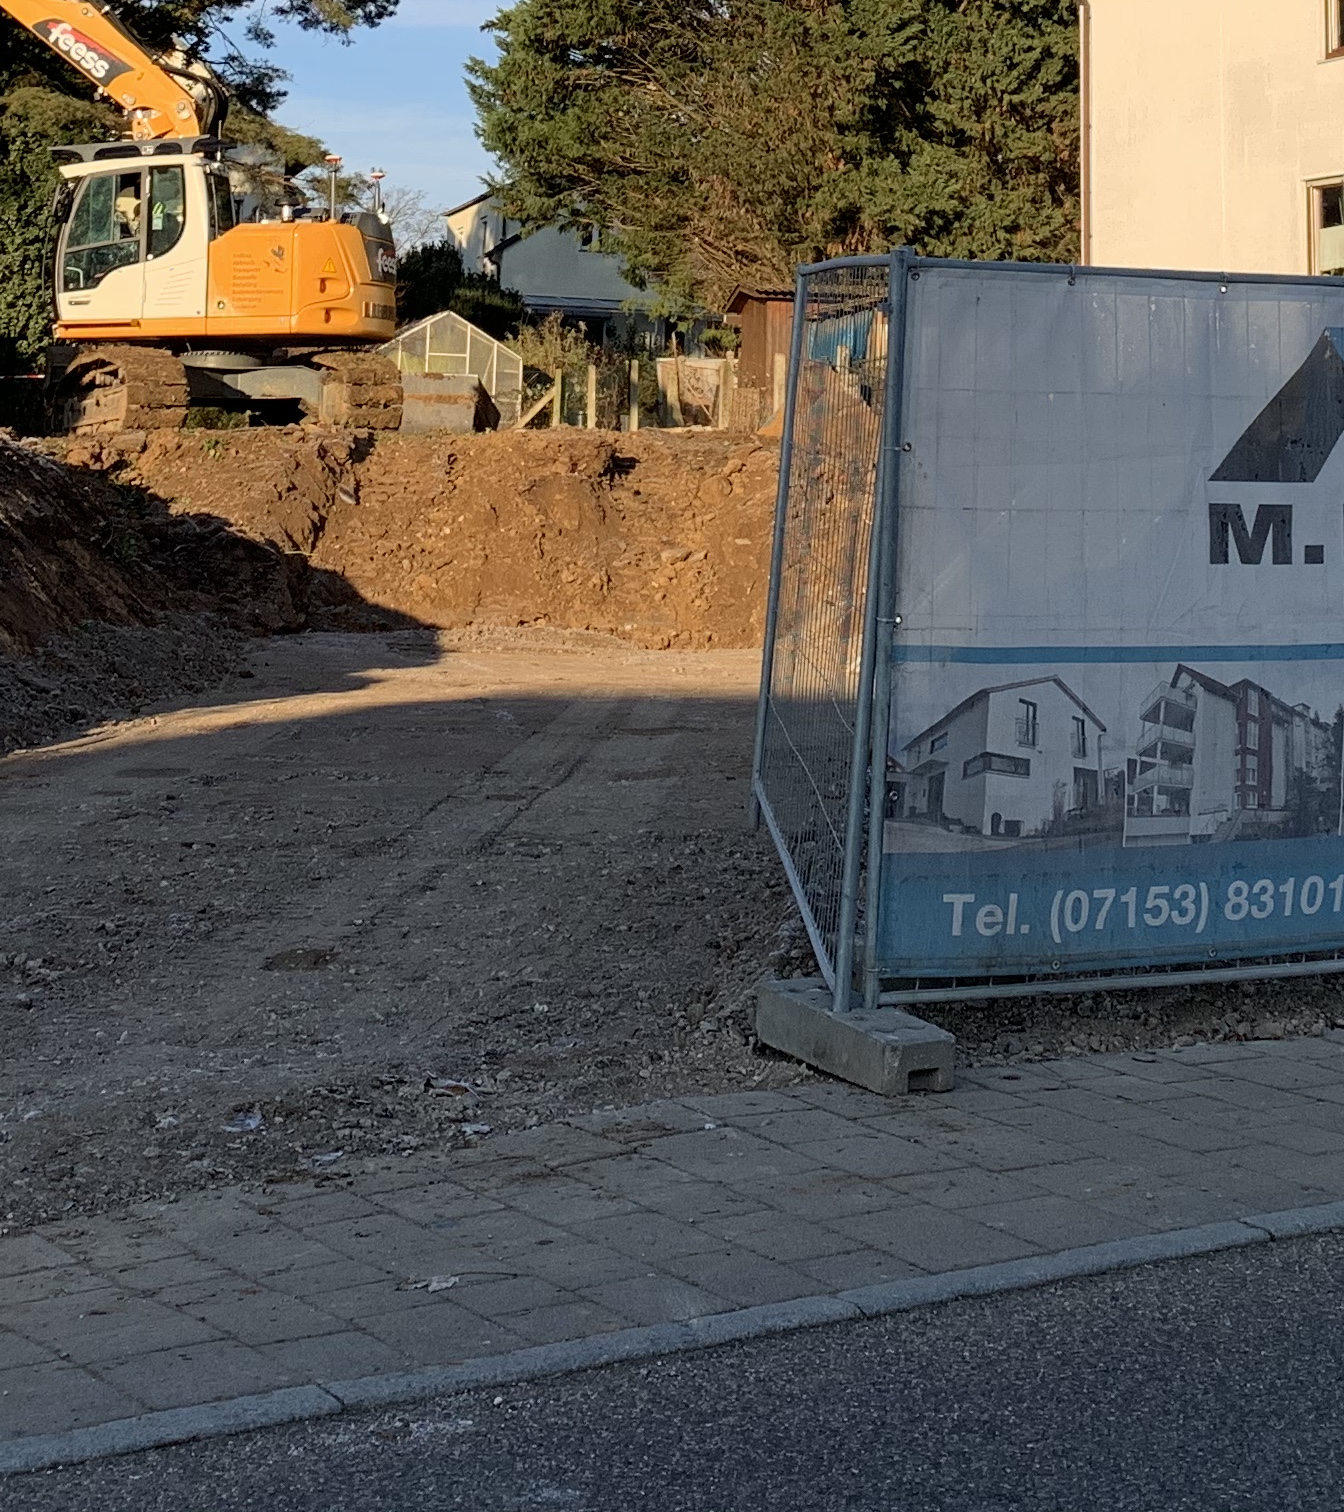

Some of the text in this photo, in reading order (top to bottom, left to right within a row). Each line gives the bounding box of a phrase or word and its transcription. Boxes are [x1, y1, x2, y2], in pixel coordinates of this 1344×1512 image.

[47, 23, 110, 79] feess
[942, 892, 1031, 937] Tel.
[1049, 882, 1210, 944] (07153)
